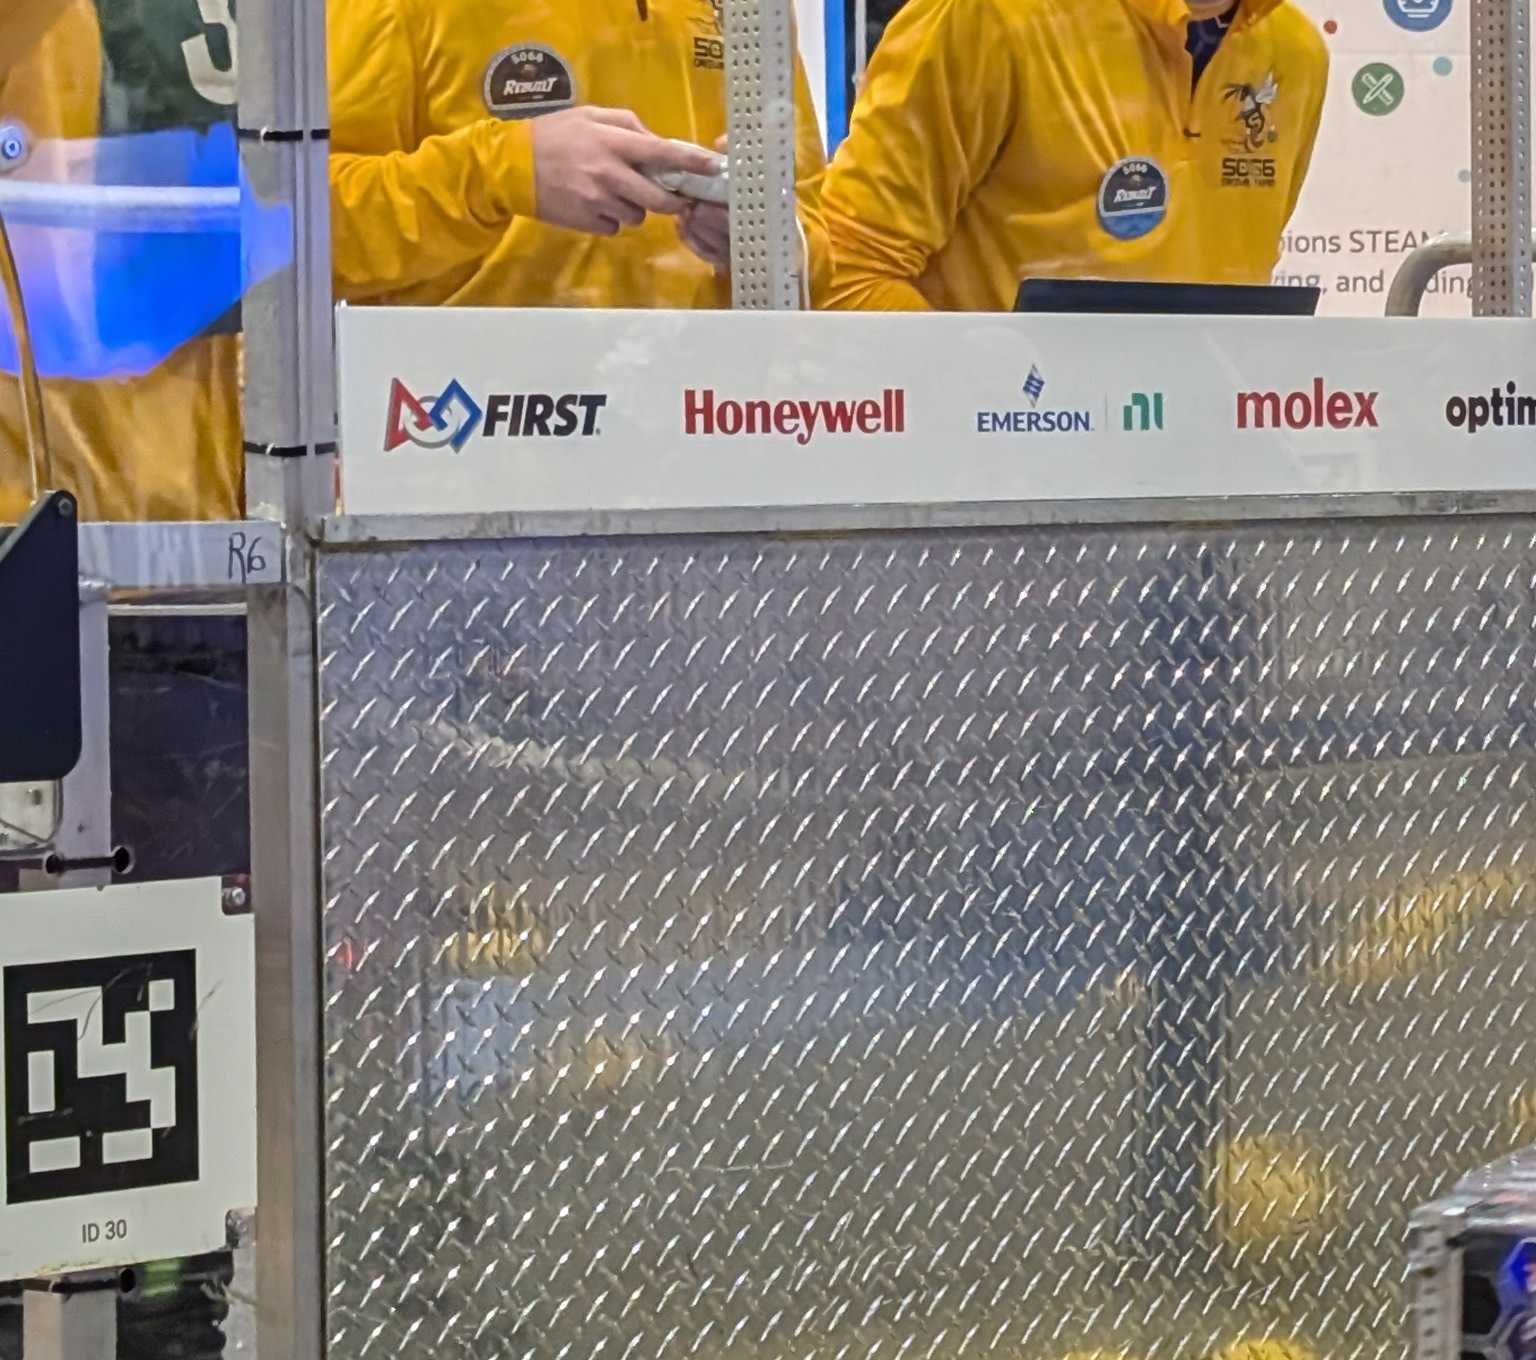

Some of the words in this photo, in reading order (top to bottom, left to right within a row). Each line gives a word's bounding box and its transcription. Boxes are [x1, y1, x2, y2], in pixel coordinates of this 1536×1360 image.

[1336, 270, 1385, 293] and
[483, 393, 606, 437] FIRST
[684, 388, 905, 444] Honeywell
[976, 410, 1091, 432] EMERSON
[1236, 377, 1379, 429] molex
[82, 1223, 100, 1243] ID
[105, 1219, 128, 1239] 30
